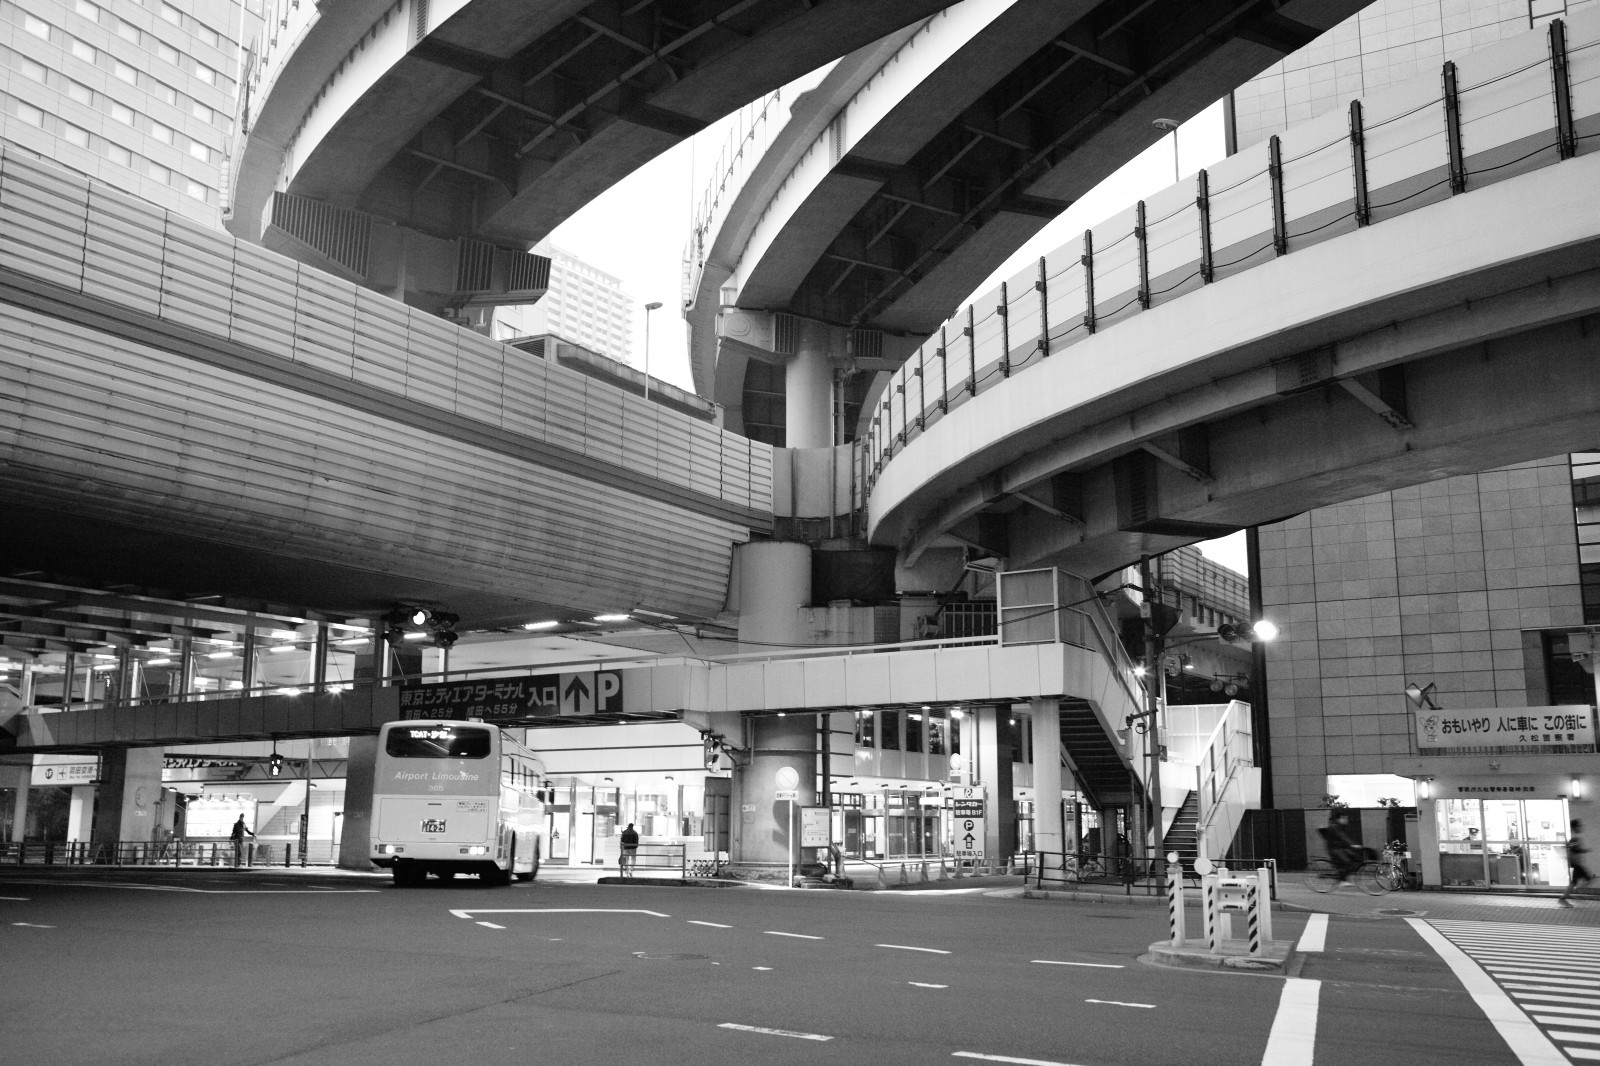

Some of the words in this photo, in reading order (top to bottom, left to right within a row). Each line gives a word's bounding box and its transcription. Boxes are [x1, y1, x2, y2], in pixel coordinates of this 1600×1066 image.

[400, 682, 525, 706] 東京シティエアターミナル
[527, 686, 557, 707] 入口
[597, 672, 620, 710] P
[465, 703, 518, 716] 成田へ55分
[1441, 718, 1490, 734] おもいやり
[1496, 716, 1538, 732] 人に車に
[1544, 715, 1587, 730] この街に
[394, 771, 428, 782] Airport
[432, 771, 479, 781] Limousine
[965, 821, 973, 830] P
